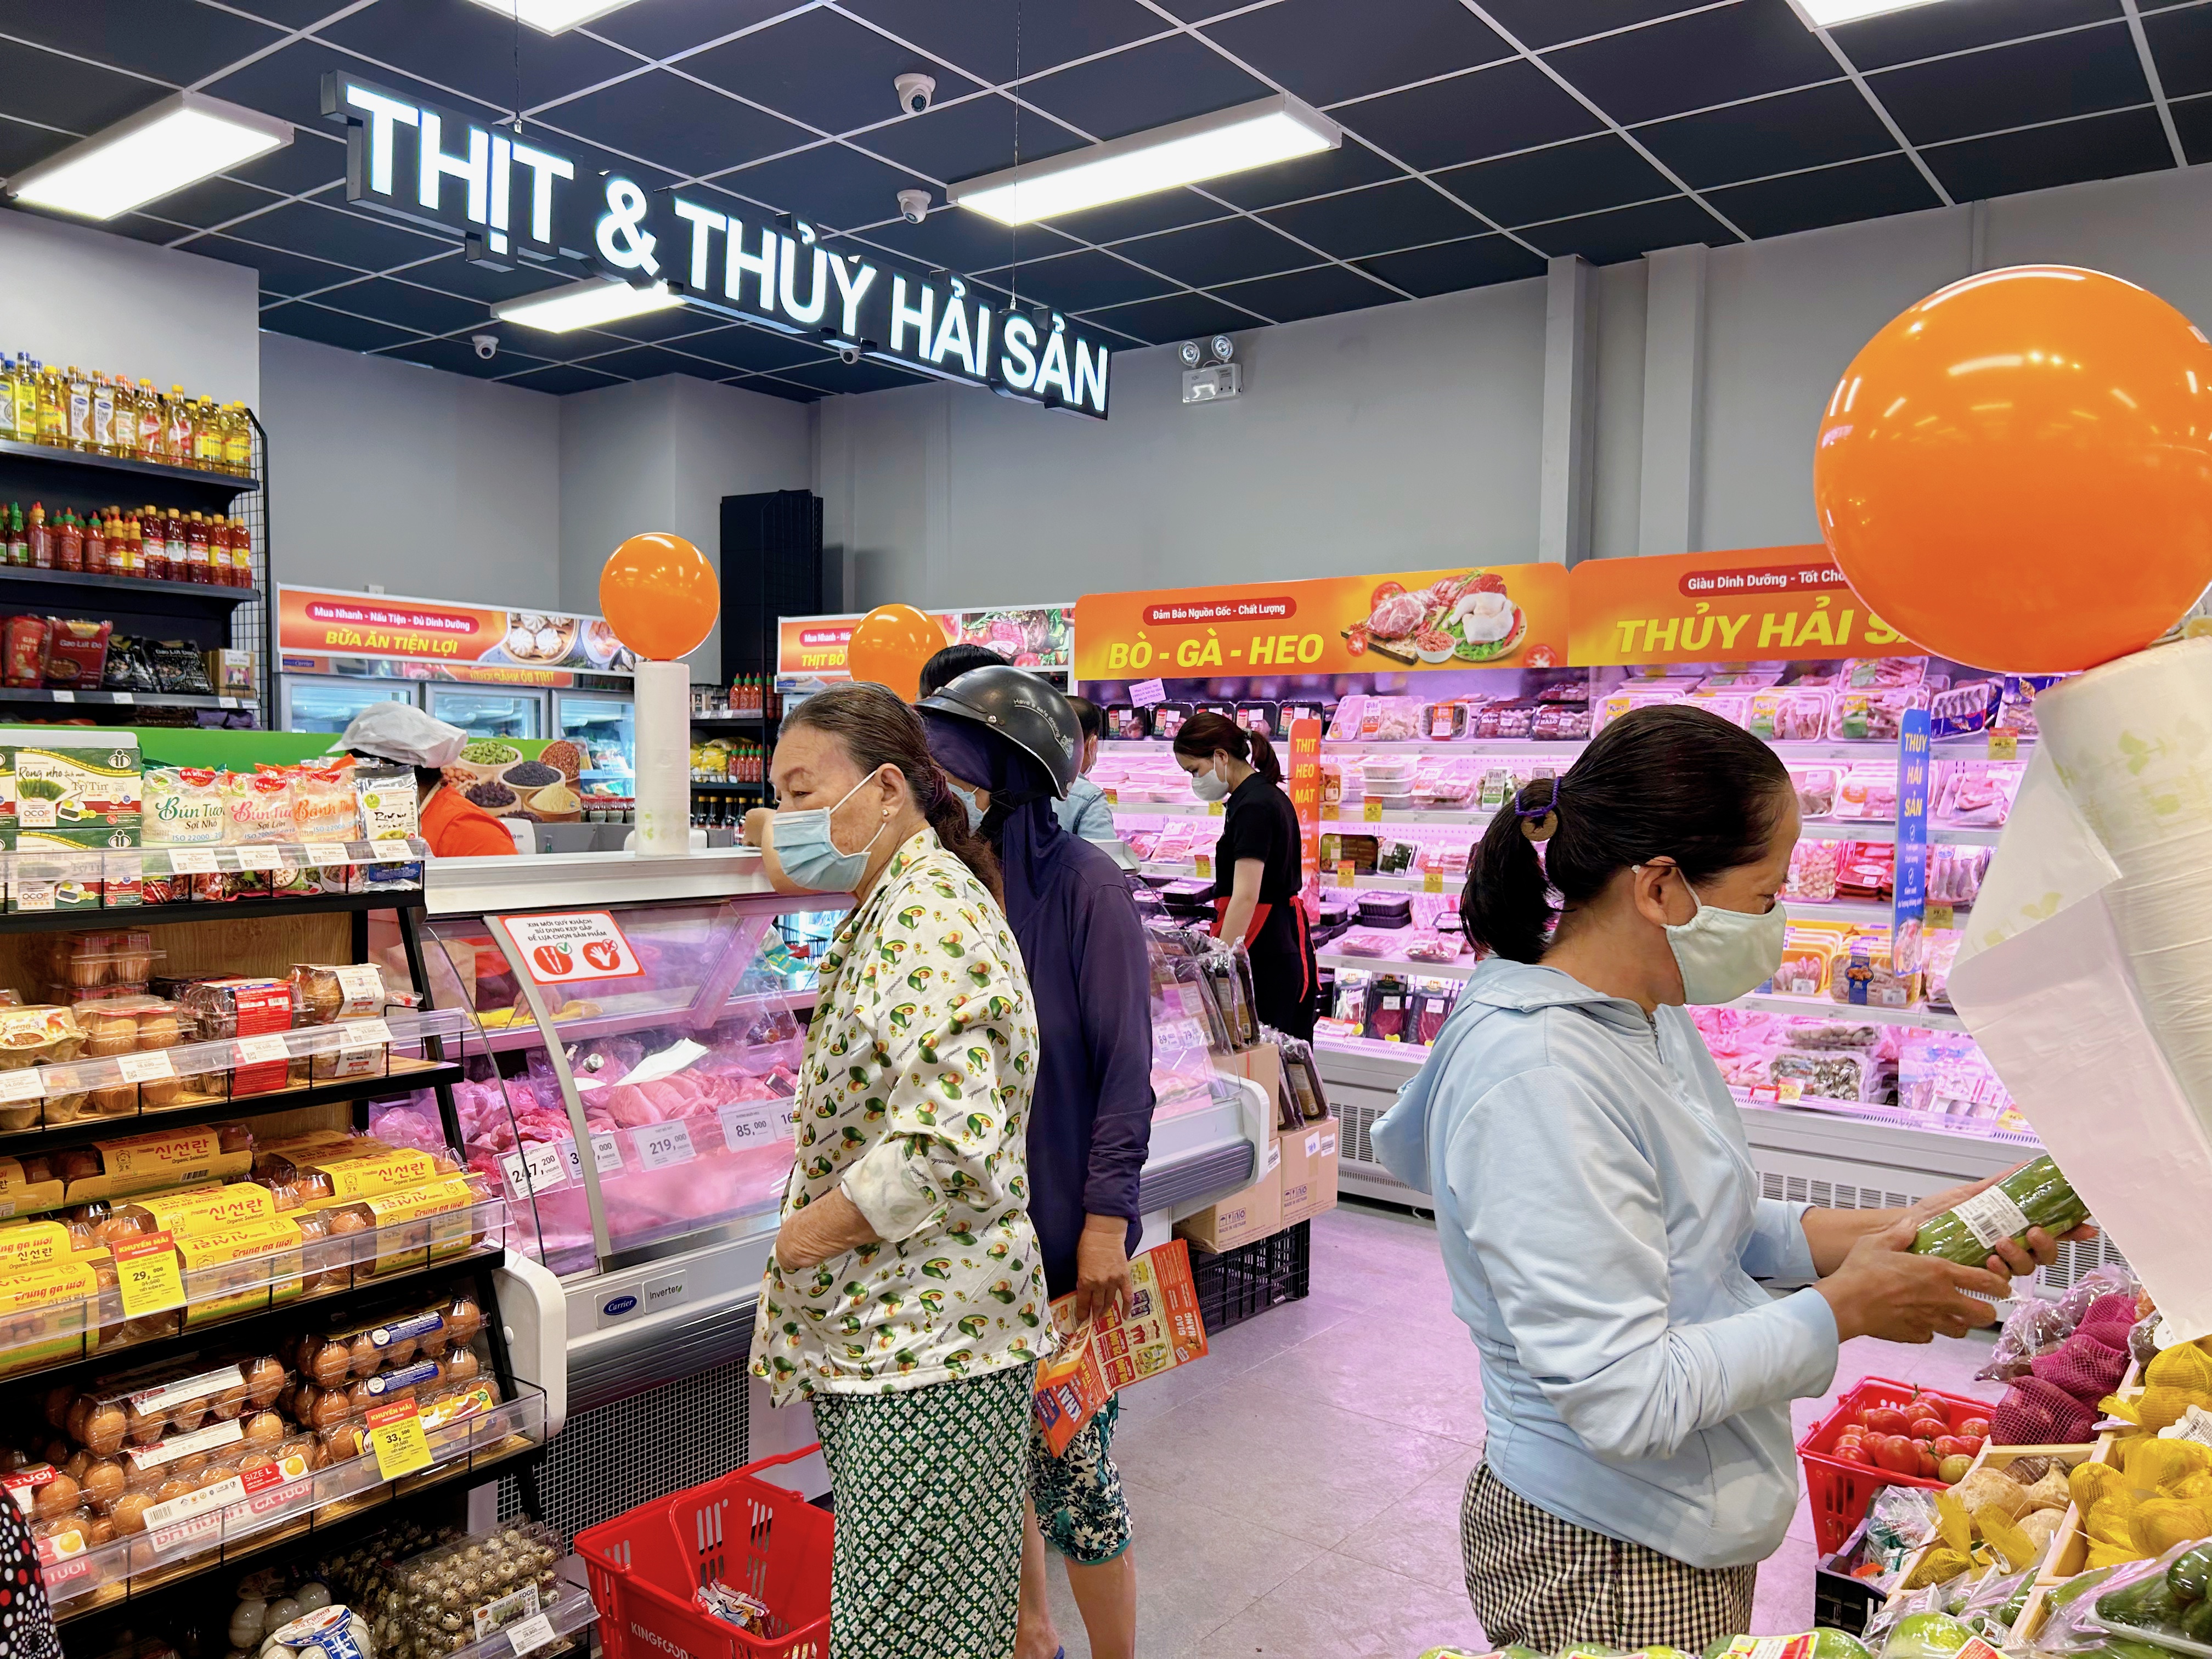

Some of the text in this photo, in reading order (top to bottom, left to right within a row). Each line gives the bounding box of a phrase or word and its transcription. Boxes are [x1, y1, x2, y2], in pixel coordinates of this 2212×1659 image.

[346, 84, 1109, 413] THỊT & THỦY HẢI SẢN
[1688, 575, 1714, 590] Giàu
[1746, 572, 1787, 588] Dưỡng
[1798, 570, 1818, 583] Tốt
[314, 607, 334, 617] Mua
[335, 608, 363, 620] Nhanh
[370, 611, 387, 623] Nấu
[389, 613, 406, 625] Tiện
[414, 616, 424, 625] Đủ
[445, 618, 470, 631] Dưỡng
[1172, 607, 1187, 620] Bảo
[1188, 606, 1214, 620] Nguồn
[1215, 604, 1232, 617] Gốc
[1238, 602, 1256, 615] Chất
[1258, 601, 1286, 617] Lượng
[1616, 596, 1854, 653] THỦY HẢI
[326, 628, 458, 657] BỮA ĂN TIỆN LỢI
[805, 633, 836, 642] Mua Nhanh
[1109, 628, 1324, 669] BÒ GÀ HEO
[802, 649, 845, 669] THỊT BÒ
[1036, 706, 1049, 718] safe
[1047, 716, 1061, 738] driving
[1296, 738, 1316, 757] THỊT
[1905, 727, 1928, 753] THỦY
[1296, 764, 1315, 778] HEO
[1907, 760, 1923, 785] HẢI
[1295, 784, 1315, 804] MÁT
[155, 797, 199, 821] Bún
[231, 801, 270, 823] Bún
[294, 799, 336, 822] Bánh
[1905, 792, 1922, 817] SẢN
[185, 821, 199, 831] Sợi
[188, 833, 210, 841] 22000
[754, 1120, 767, 1129] 000
[599, 1142, 613, 1152] 000
[675, 1133, 686, 1142] 000
[155, 1139, 209, 1160] 신선란
[172, 1153, 210, 1165] Organic Selenium
[541, 1155, 555, 1166] 200
[378, 1161, 426, 1182] 신선란
[209, 1198, 263, 1221] 신선란
[227, 1212, 264, 1225] Organic Selenium
[18, 1246, 53, 1262] 신선란
[118, 1236, 170, 1254] KHUYẾN MÃI
[9, 1256, 54, 1270] Organic Selenium
[133, 1271, 151, 1282] 29,
[608, 1284, 680, 1312] Carrier Inverter
[1175, 1314, 1186, 1335] GIAO
[370, 1403, 413, 1421] KHUYẾN MÃI
[1057, 1385, 1082, 1423] KHAI
[386, 1433, 402, 1444] 33,
[244, 1471, 264, 1482] SIZE
[518, 1588, 535, 1601] FOOD
[631, 1621, 688, 1659] KINGFOOD
